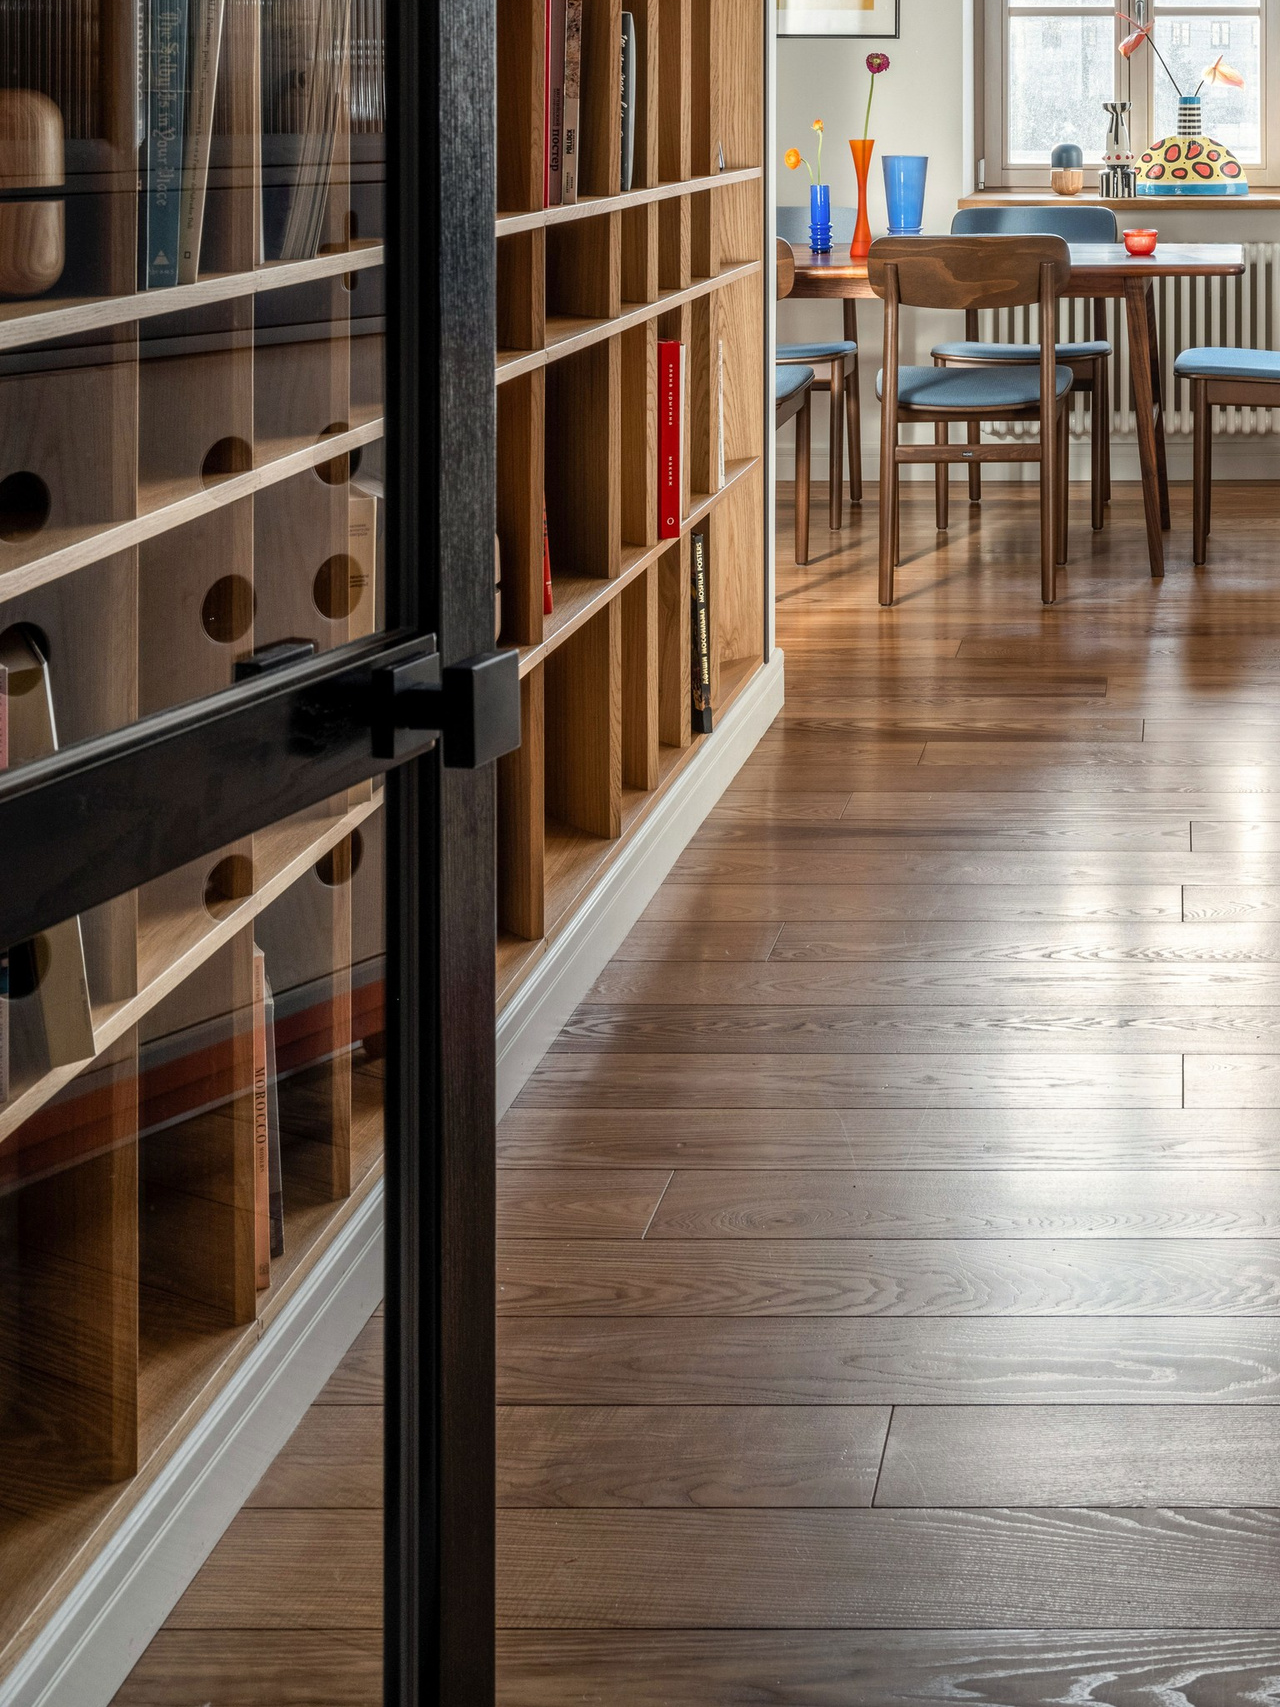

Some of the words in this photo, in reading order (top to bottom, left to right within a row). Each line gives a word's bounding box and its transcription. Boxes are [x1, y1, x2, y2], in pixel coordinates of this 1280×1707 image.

[156, 7, 182, 38] The
[155, 42, 180, 87] Selby
[158, 113, 174, 126] in
[153, 127, 177, 164] Your
[550, 129, 560, 172] постер
[156, 166, 175, 206] Place
[697, 573, 705, 603] MOSFILM
[699, 608, 708, 655] МОСФИЛЬМА
[701, 656, 709, 685] АФИШИ
[255, 1066, 267, 1145] MOROCCO
